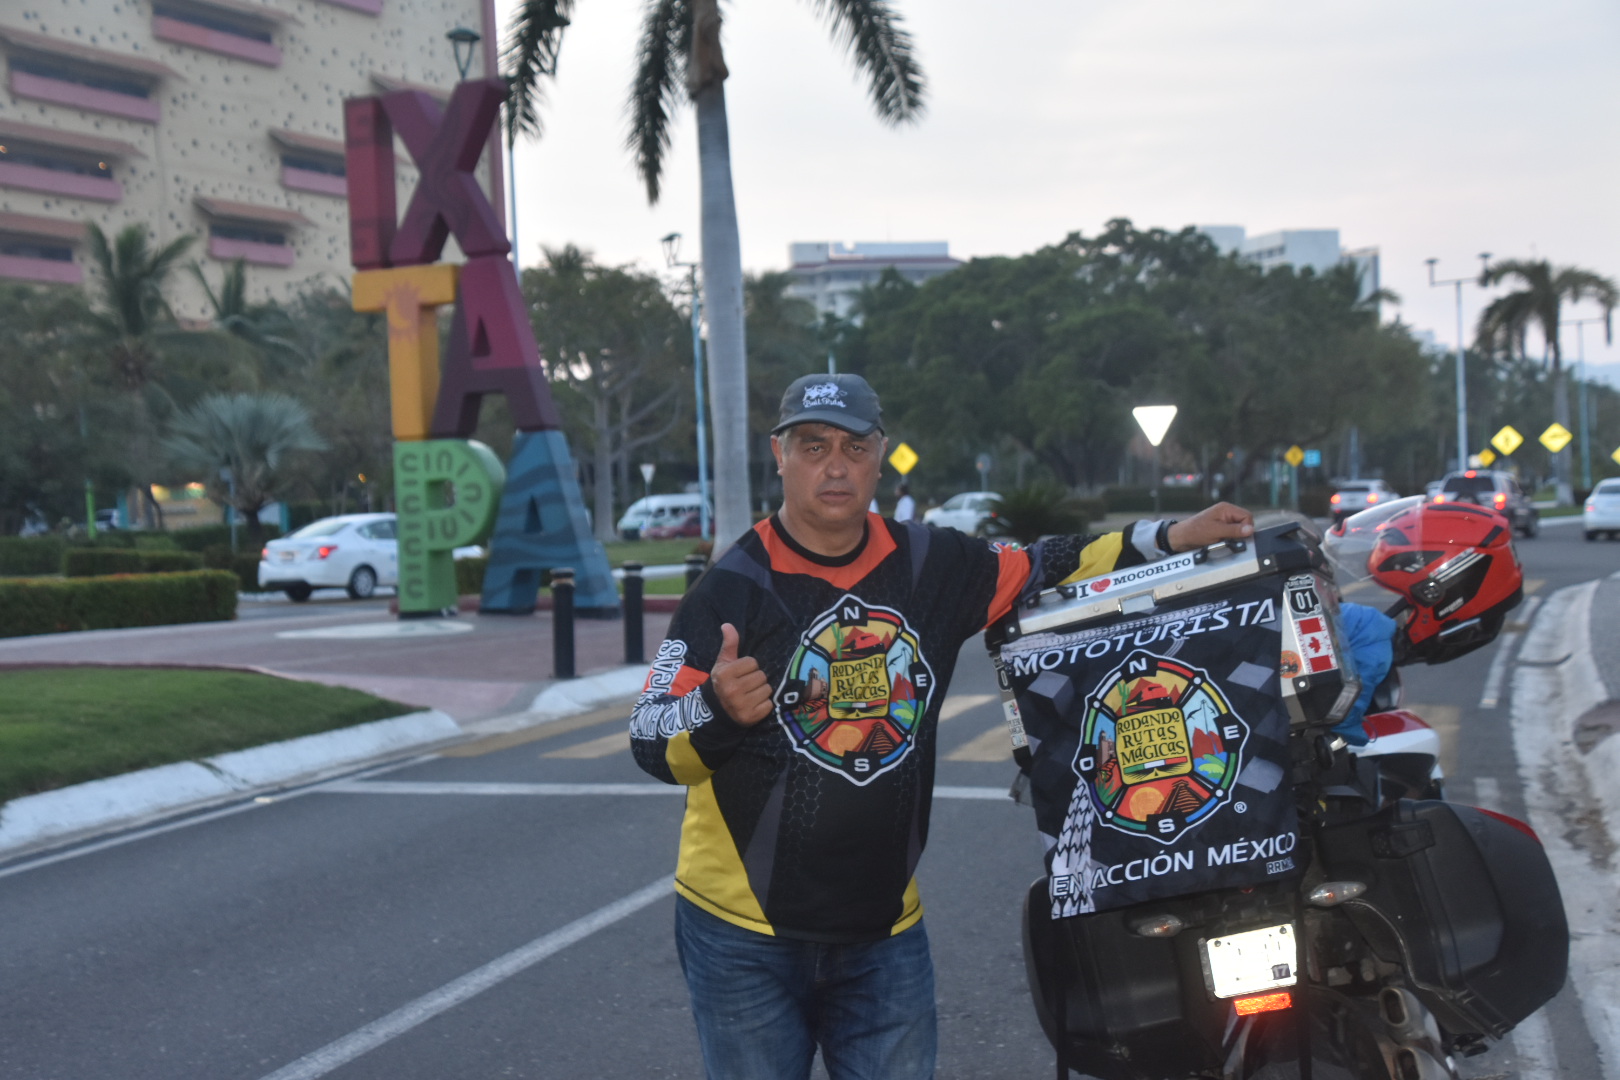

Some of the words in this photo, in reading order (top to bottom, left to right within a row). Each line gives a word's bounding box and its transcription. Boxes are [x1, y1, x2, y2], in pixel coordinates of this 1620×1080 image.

[343, 76, 512, 270] IX
[352, 255, 561, 440] TA
[392, 429, 622, 615] PA
[1078, 583, 1089, 598] I
[1112, 557, 1191, 586] MOCORITO
[1295, 590, 1313, 610] 01
[843, 606, 860, 620] N
[1013, 598, 1276, 677] MOTOTURISTA
[1128, 657, 1147, 674] N
[915, 673, 928, 687] E
[783, 691, 799, 704] O
[1116, 710, 1181, 735] RODANDO
[1122, 726, 1178, 749] RUTAS
[1223, 724, 1241, 740] E
[853, 758, 870, 772] S
[1079, 756, 1095, 772] O
[1157, 818, 1176, 834] S
[1091, 850, 1194, 890] ACCIÓN
[1207, 832, 1297, 867] MÉXICO
[1273, 964, 1290, 980] 17
